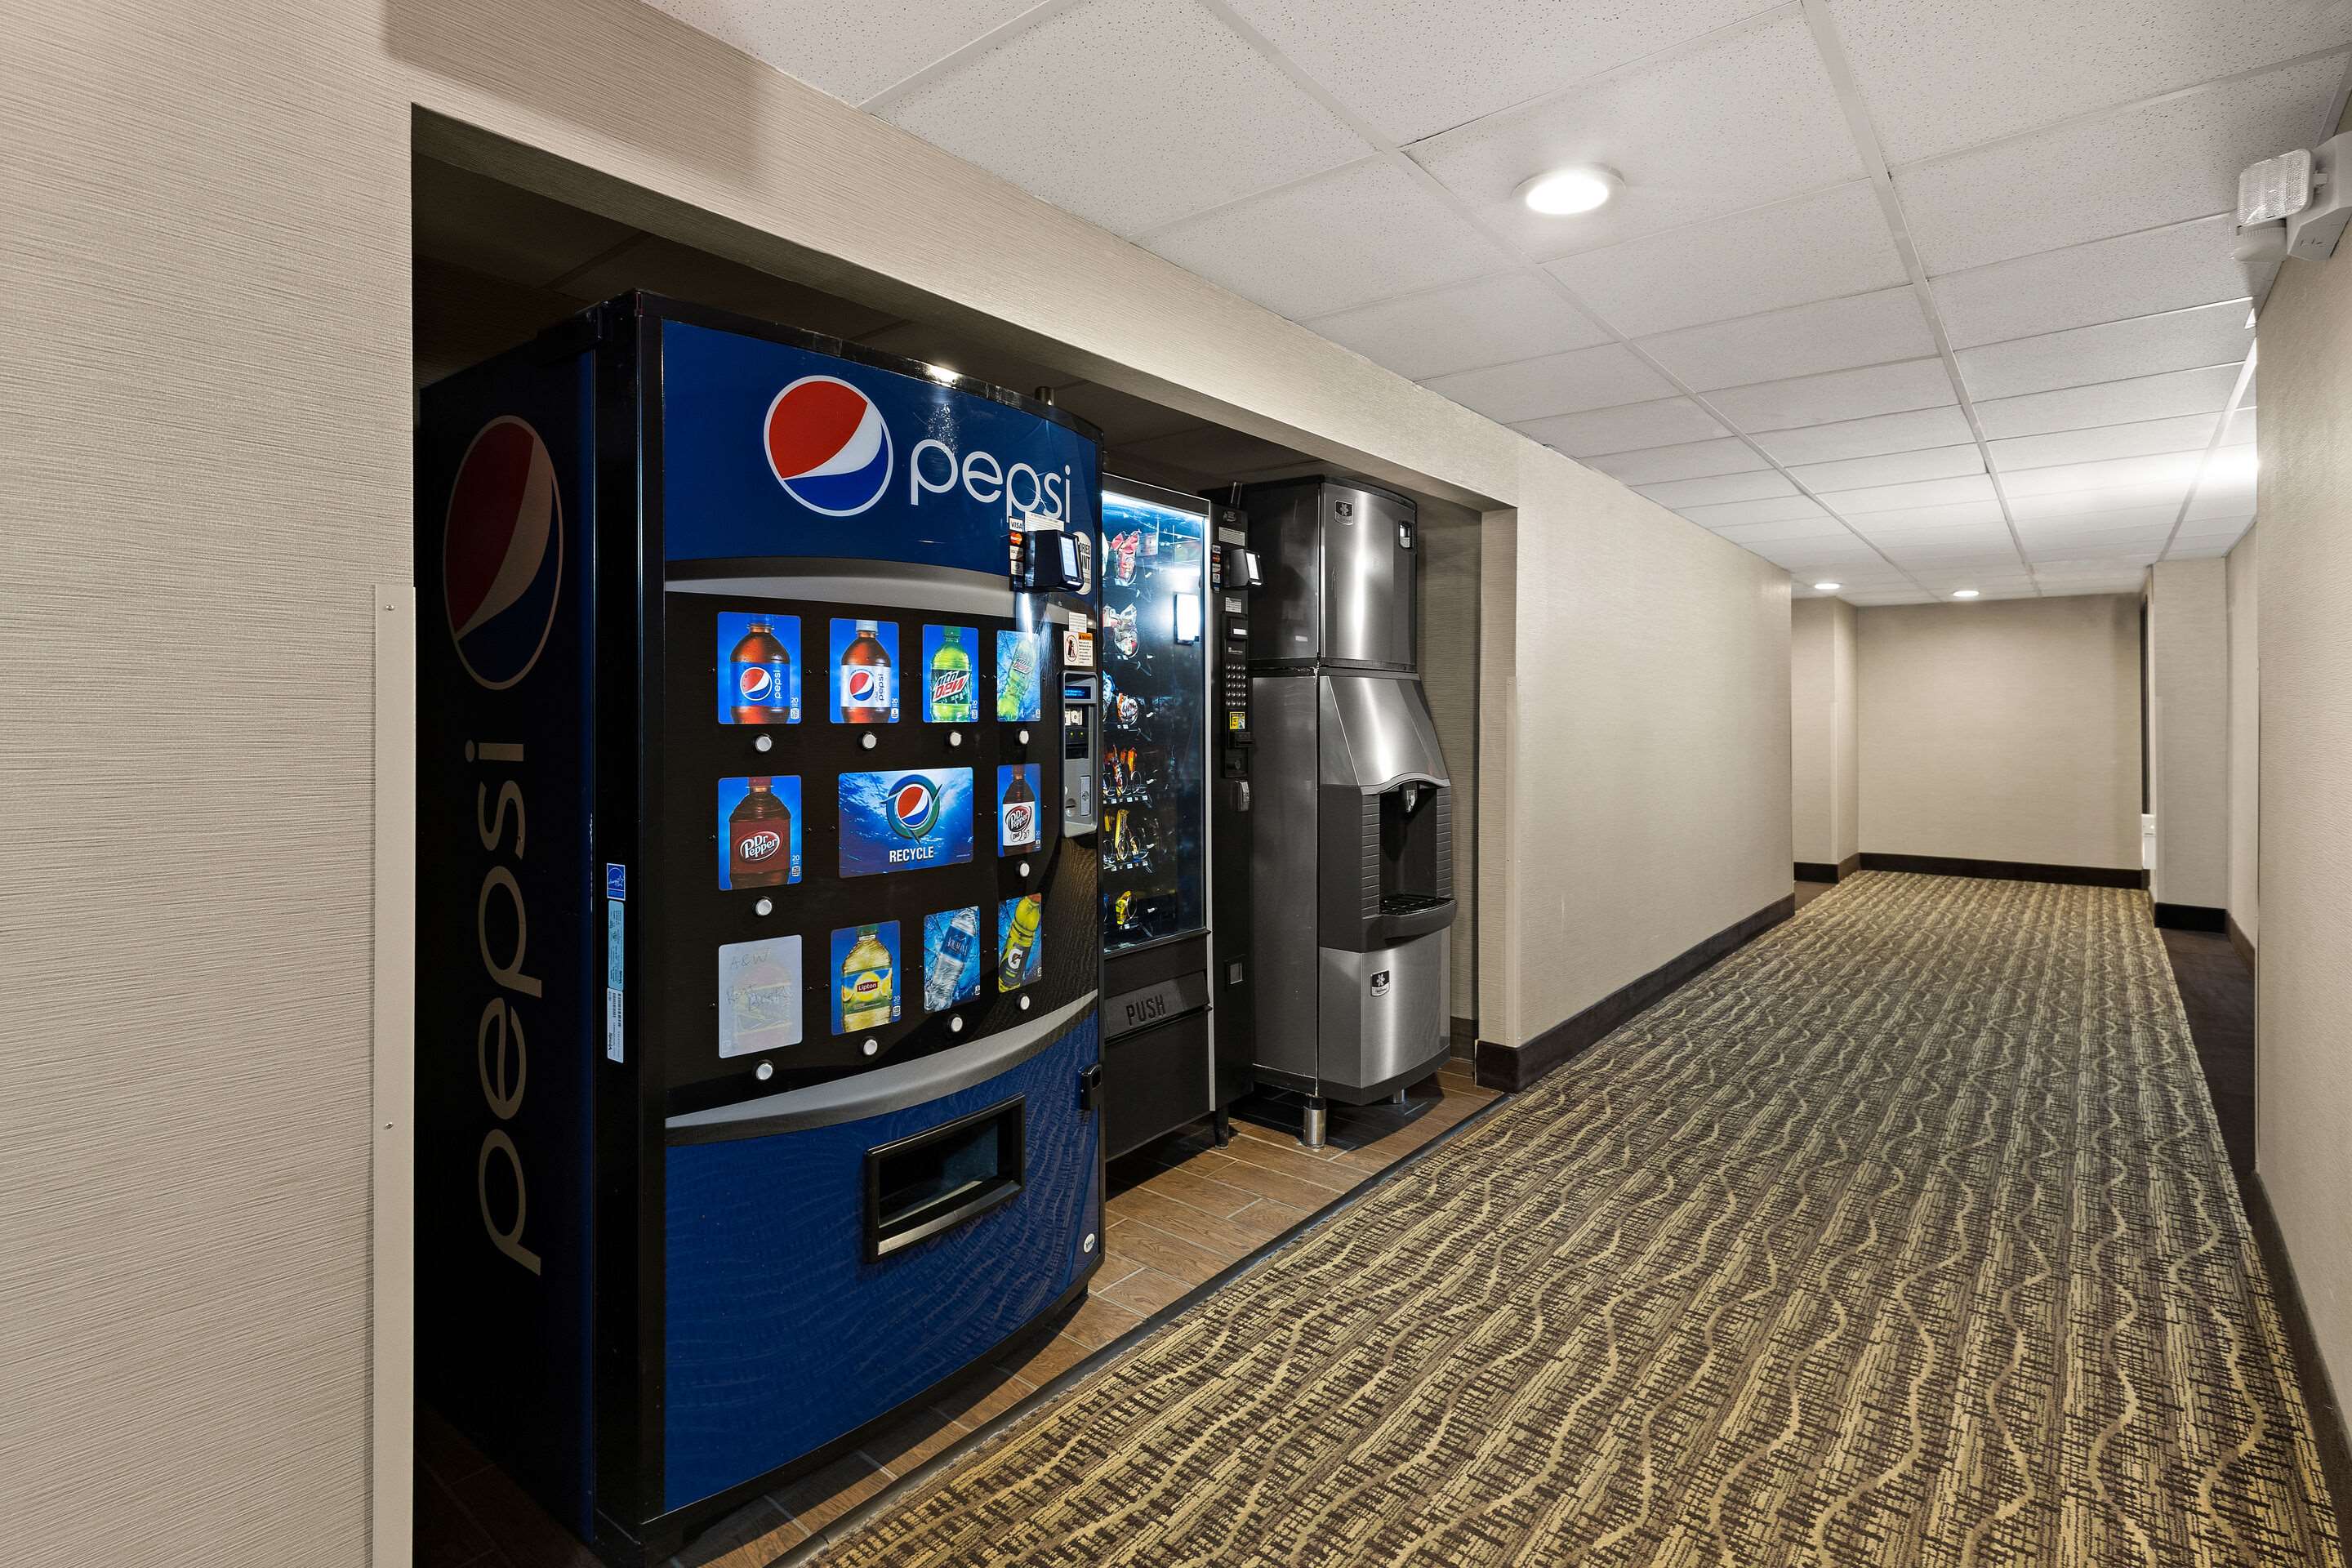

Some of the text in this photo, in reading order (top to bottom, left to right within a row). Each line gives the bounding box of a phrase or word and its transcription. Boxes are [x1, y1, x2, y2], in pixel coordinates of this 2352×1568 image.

[911, 439, 1071, 523] pepsi
[1011, 520, 1022, 529] VISA
[773, 669, 782, 700] pepsi
[877, 673, 885, 702] pepsi
[1010, 813, 1029, 830] Pepper
[744, 838, 778, 859] Pepper
[755, 835, 769, 846] Dr
[889, 846, 934, 863] RECYCLE
[1008, 948, 1023, 969] G
[858, 982, 877, 991] Lipton
[466, 739, 542, 1276] pepsi
[1125, 994, 1166, 1027] PUSH
